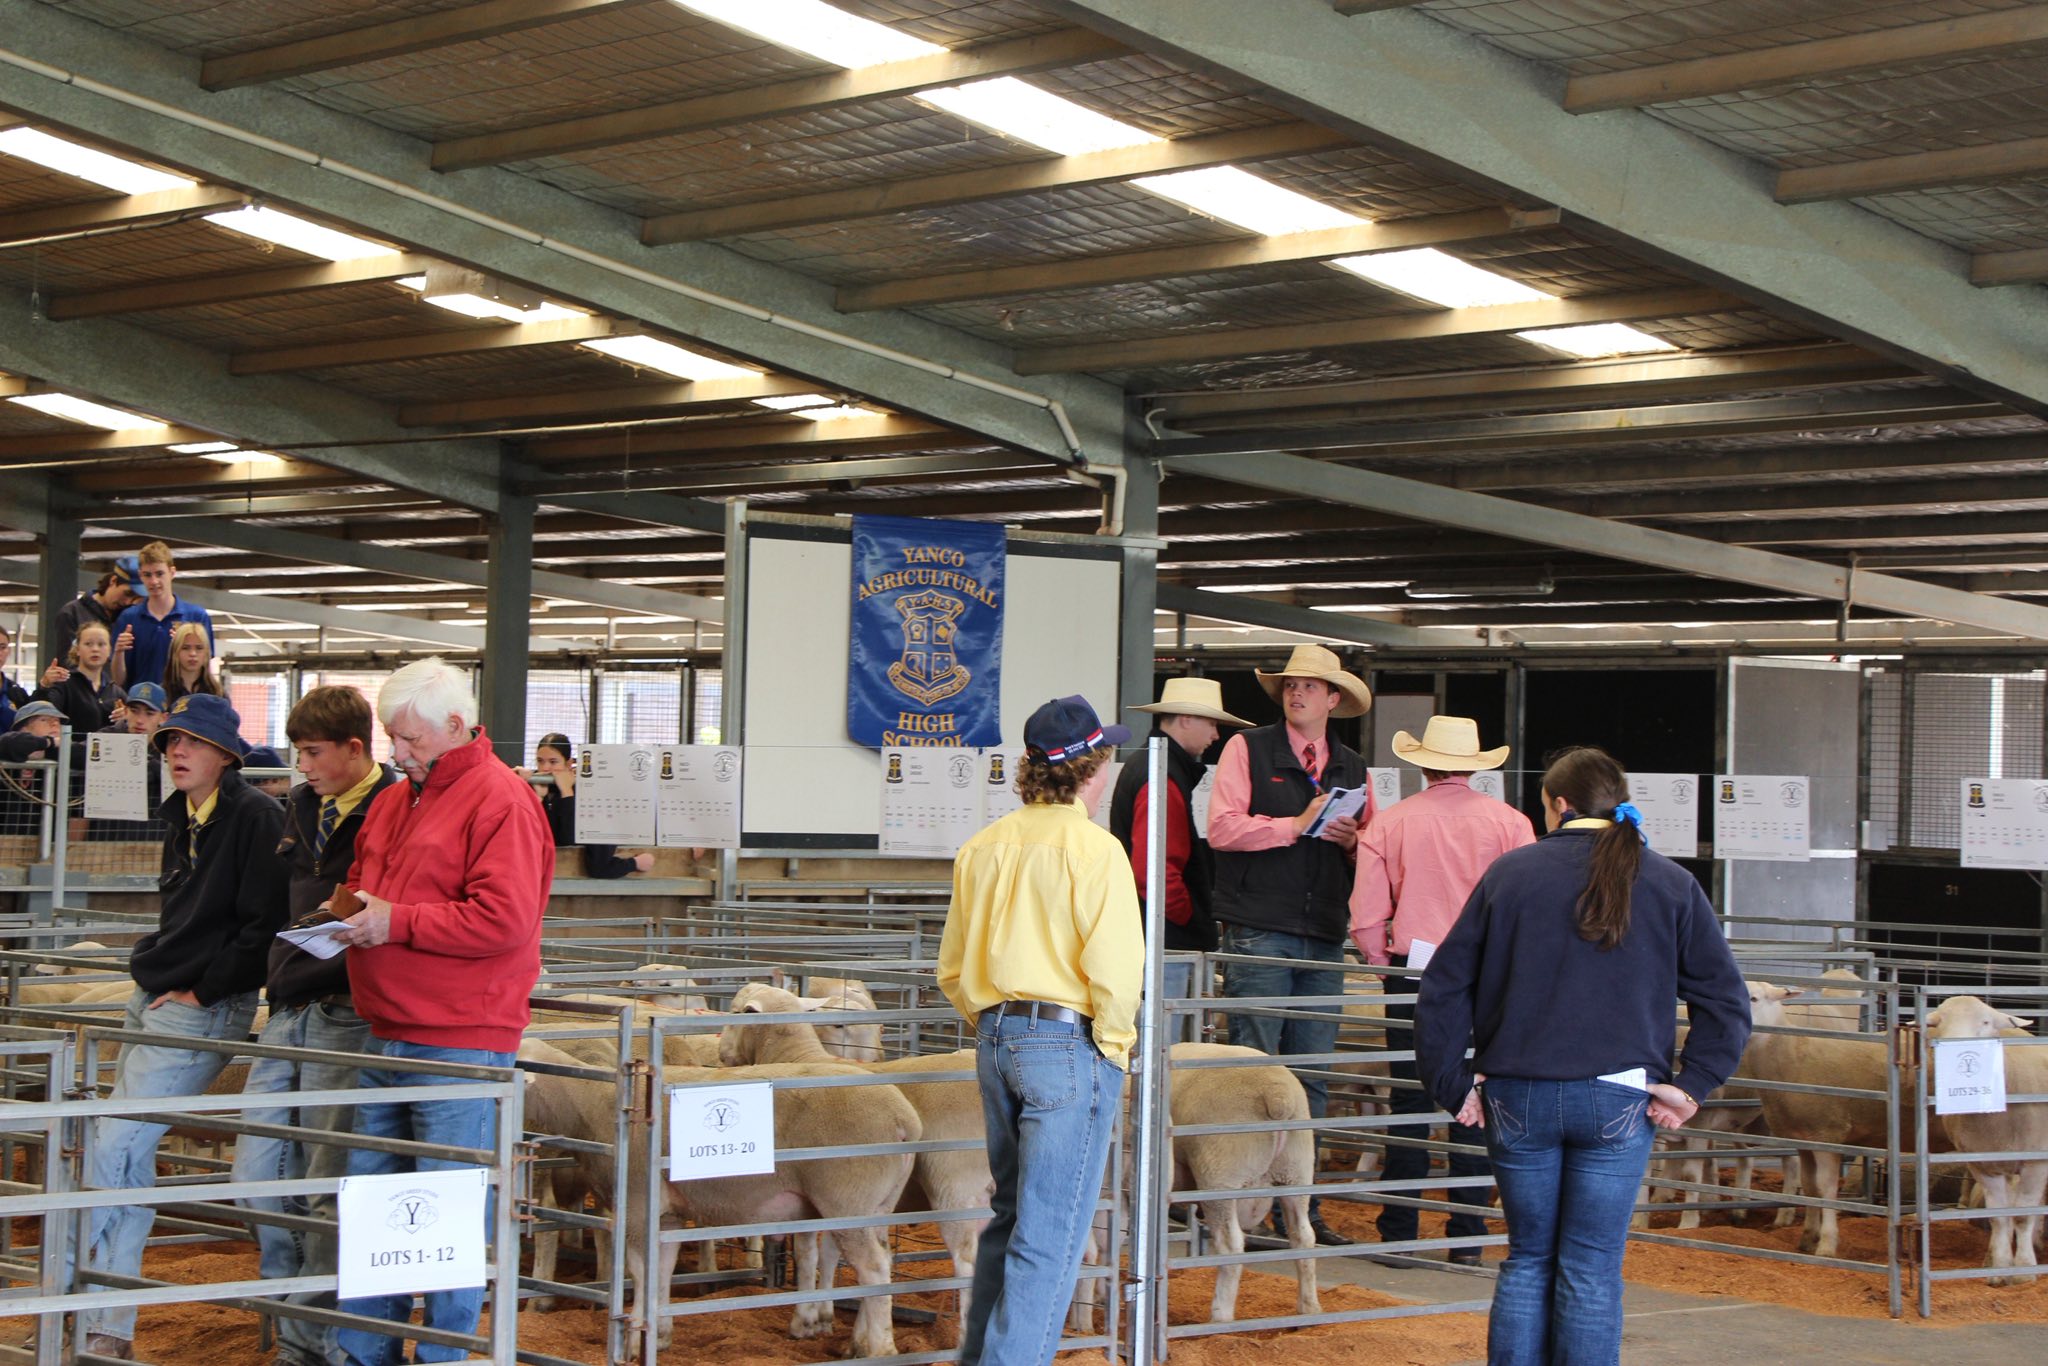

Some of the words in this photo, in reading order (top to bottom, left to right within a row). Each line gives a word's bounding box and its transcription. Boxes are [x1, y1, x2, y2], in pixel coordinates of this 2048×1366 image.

[902, 547, 965, 567] YANCO
[858, 568, 999, 609] AGRICULTURAL
[896, 711, 955, 733] HIGH
[1945, 884, 1959, 896] 31
[716, 1107, 728, 1126] Y
[689, 1145, 718, 1158] LOTS
[405, 1202, 421, 1226] Y
[370, 1250, 411, 1267] LOTS
